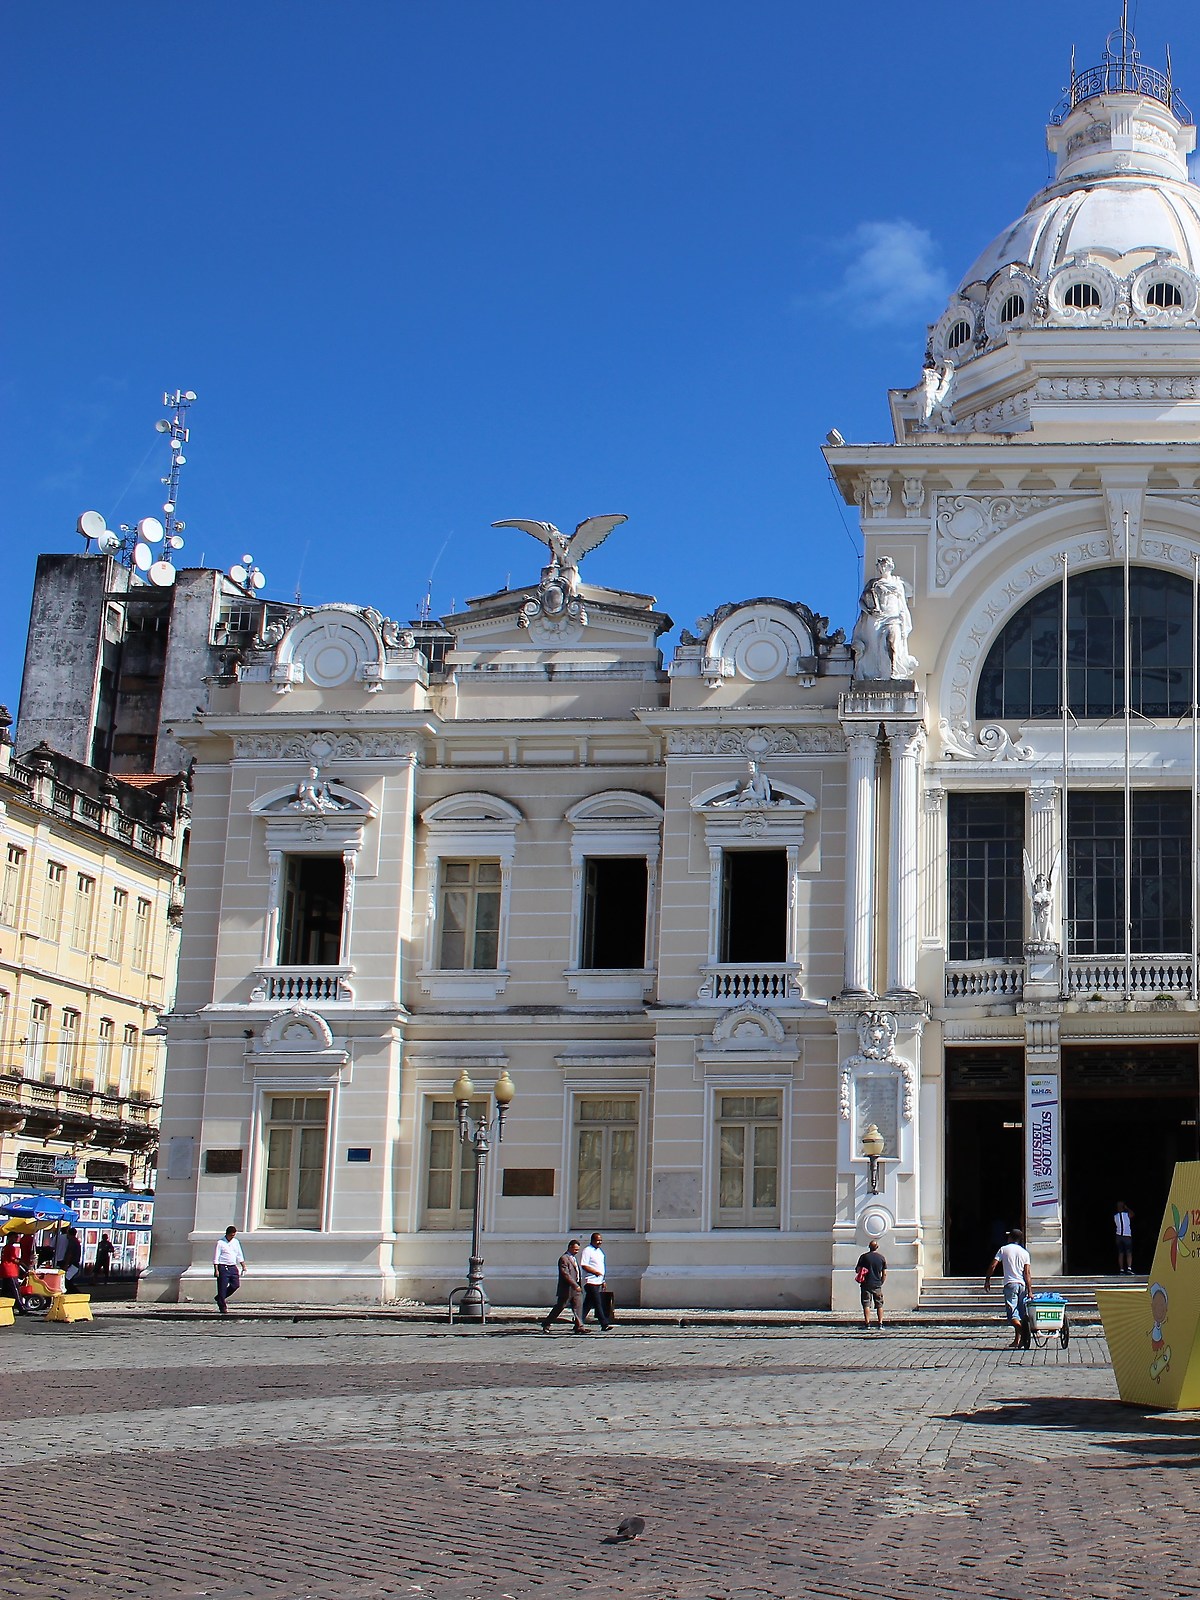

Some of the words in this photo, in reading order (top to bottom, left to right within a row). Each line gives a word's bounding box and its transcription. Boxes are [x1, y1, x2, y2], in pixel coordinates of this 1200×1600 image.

[1041, 1111, 1052, 1146] MAIS
[1032, 1122, 1042, 1177] #MUSEU
[1042, 1148, 1052, 1176] SOU
[1191, 1209, 1200, 1226] 12
[1191, 1231, 1200, 1242] Dia
[1191, 1250, 1196, 1258] o
